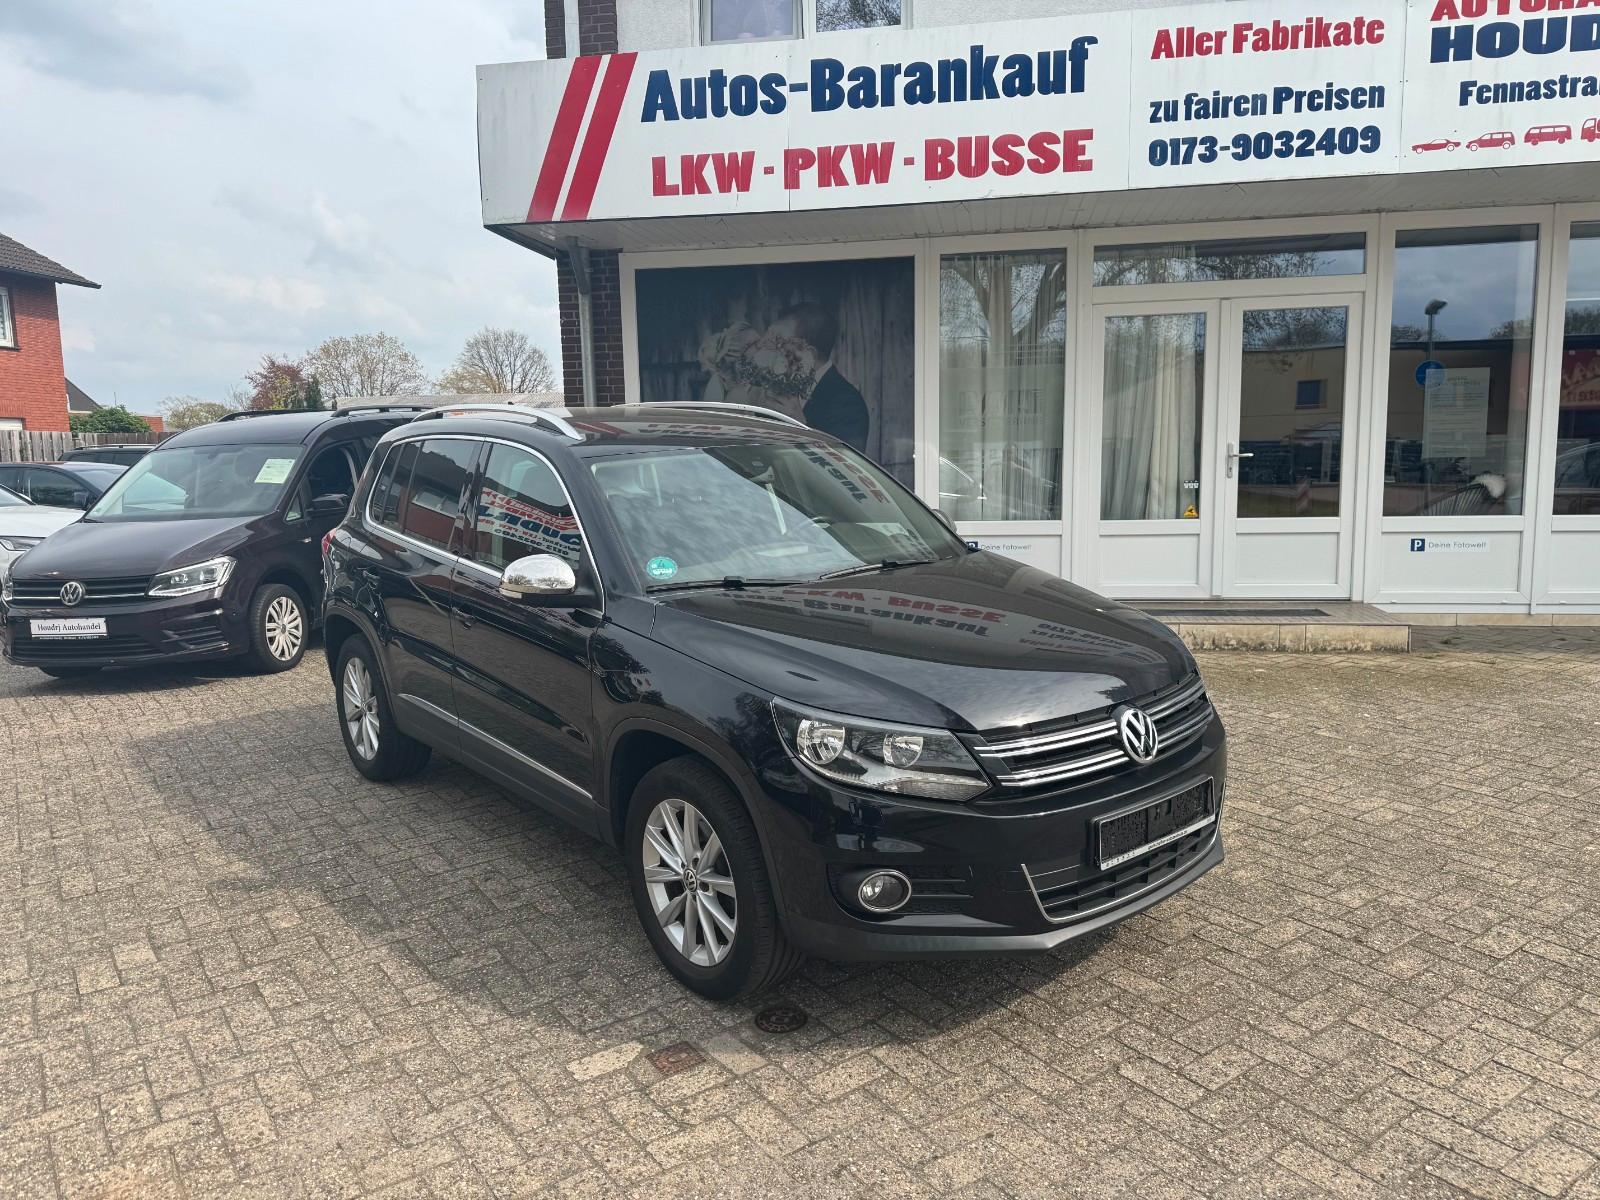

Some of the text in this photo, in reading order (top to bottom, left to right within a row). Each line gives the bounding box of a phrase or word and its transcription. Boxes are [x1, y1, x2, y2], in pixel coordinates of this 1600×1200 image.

[1151, 16, 1385, 60] Aller Fabrikate
[641, 36, 1099, 123] Autos-Barankauf
[1459, 74, 1600, 107] Fennastra
[1150, 82, 1386, 124] zu fairen Preisen
[652, 151, 756, 196] LKW
[784, 141, 896, 190] PKW
[924, 128, 1094, 181] BUSSE
[1149, 125, 1381, 167] 0173-9032409
[62, 622, 101, 631] Autohandel
